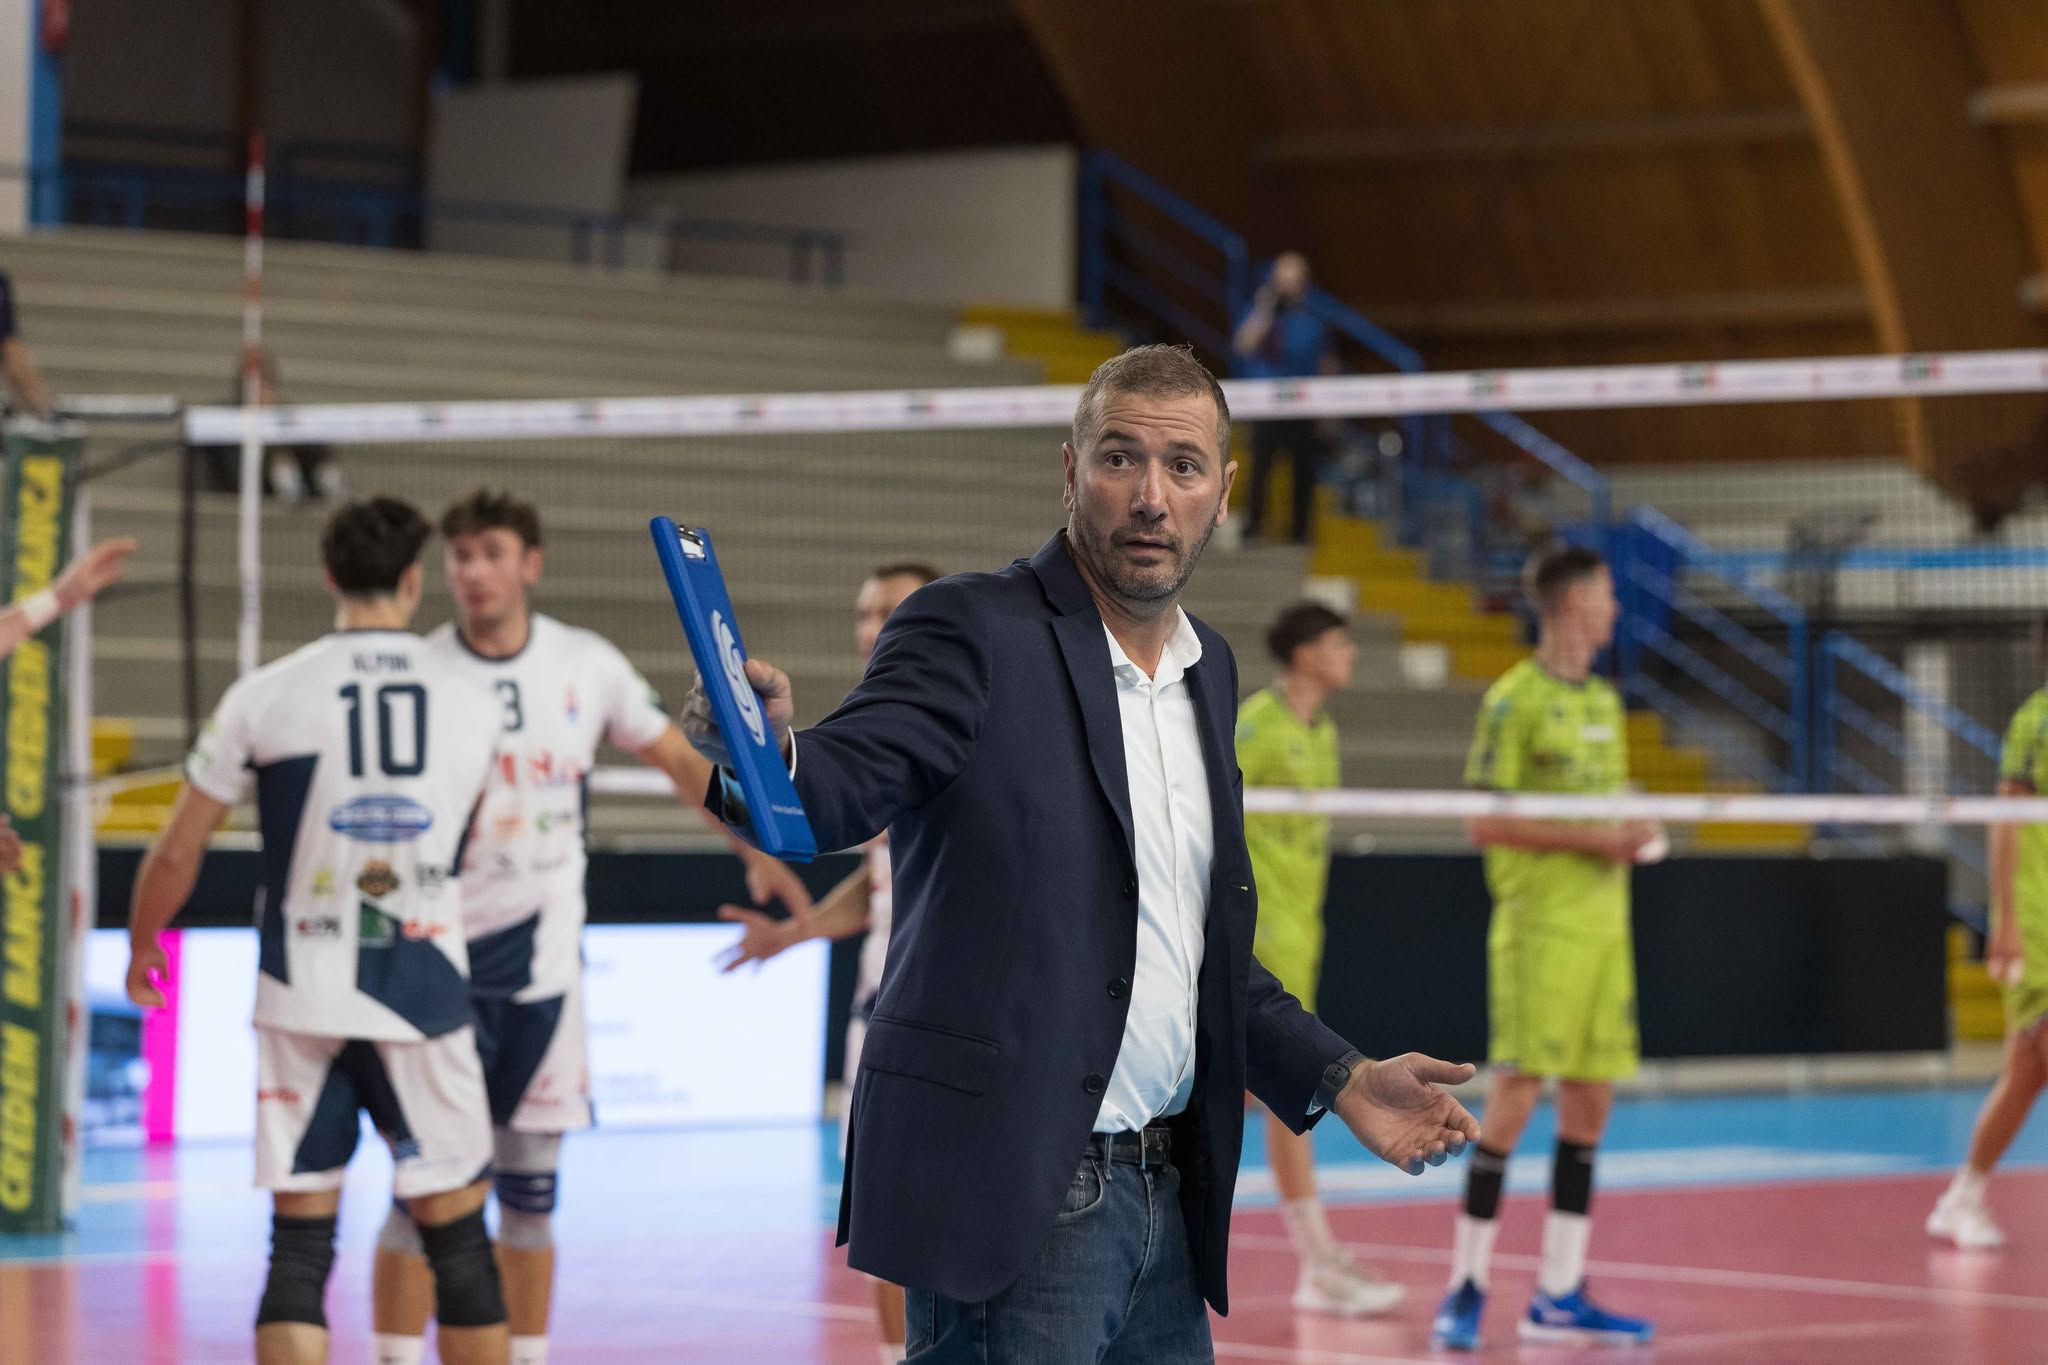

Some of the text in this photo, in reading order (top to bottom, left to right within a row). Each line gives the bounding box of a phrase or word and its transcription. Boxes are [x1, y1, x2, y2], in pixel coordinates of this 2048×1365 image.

[339, 683, 428, 777] 10
[497, 679, 524, 732] 3
[2, 1022, 39, 1212] CREDEM
